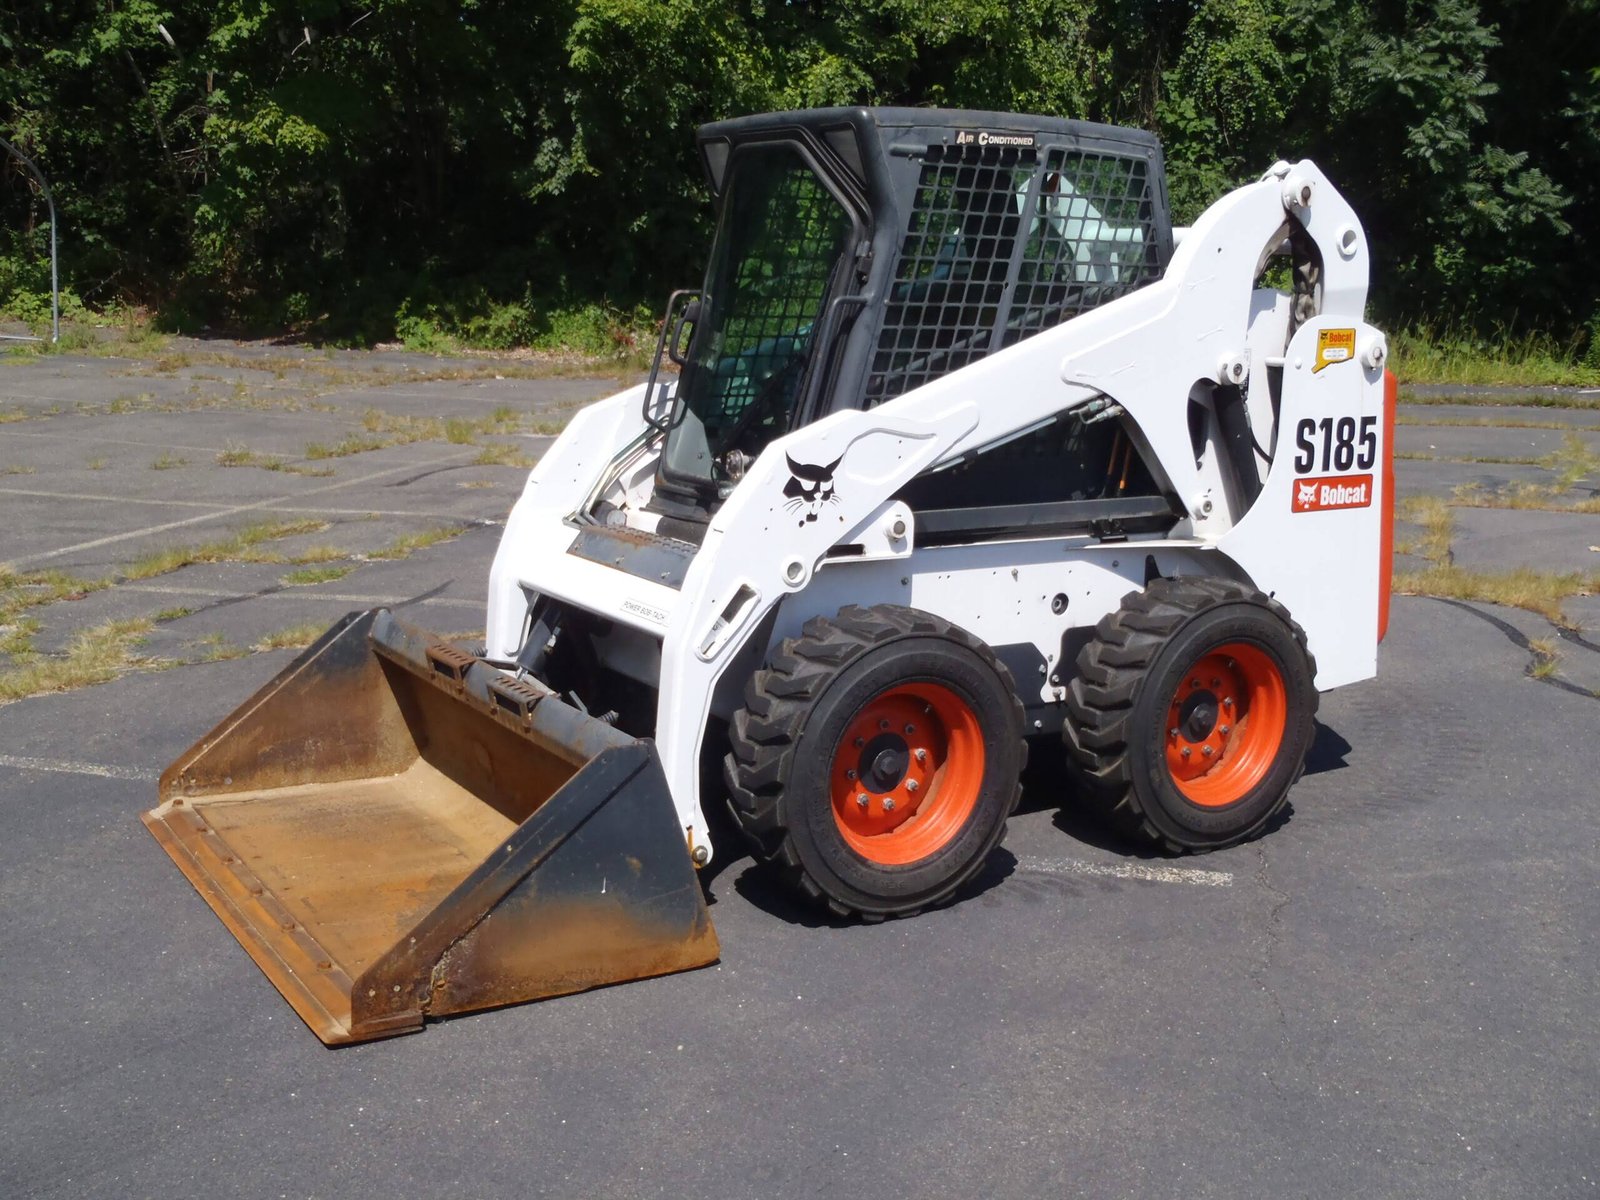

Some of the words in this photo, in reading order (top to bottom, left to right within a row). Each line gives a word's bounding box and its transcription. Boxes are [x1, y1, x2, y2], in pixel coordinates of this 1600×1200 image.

[1328, 332, 1352, 343] Bobcat
[1294, 416, 1377, 474] S185
[1319, 483, 1367, 506] Bobcat
